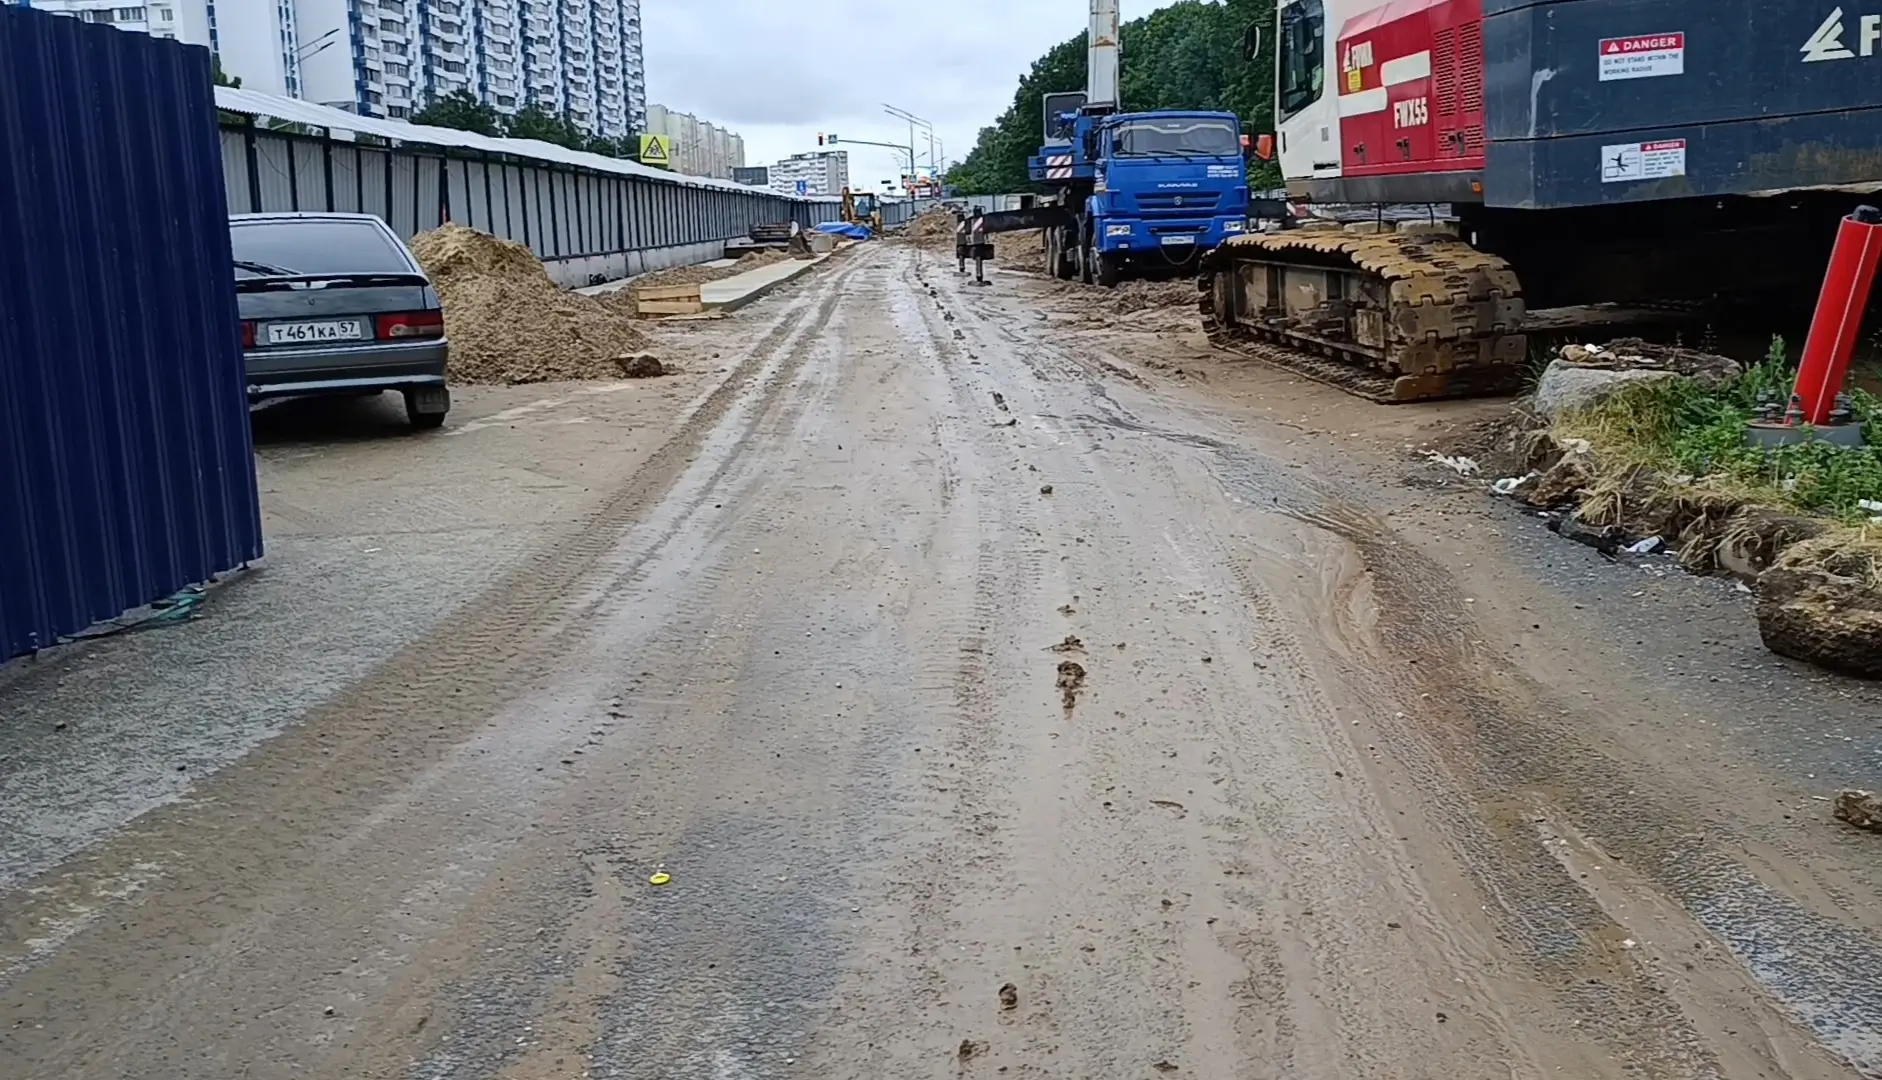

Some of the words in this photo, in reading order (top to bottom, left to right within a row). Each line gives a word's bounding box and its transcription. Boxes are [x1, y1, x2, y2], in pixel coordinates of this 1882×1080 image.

[1623, 37, 1677, 51] DANGER
[1860, 14, 1882, 56] F
[1393, 97, 1428, 129] FWX55
